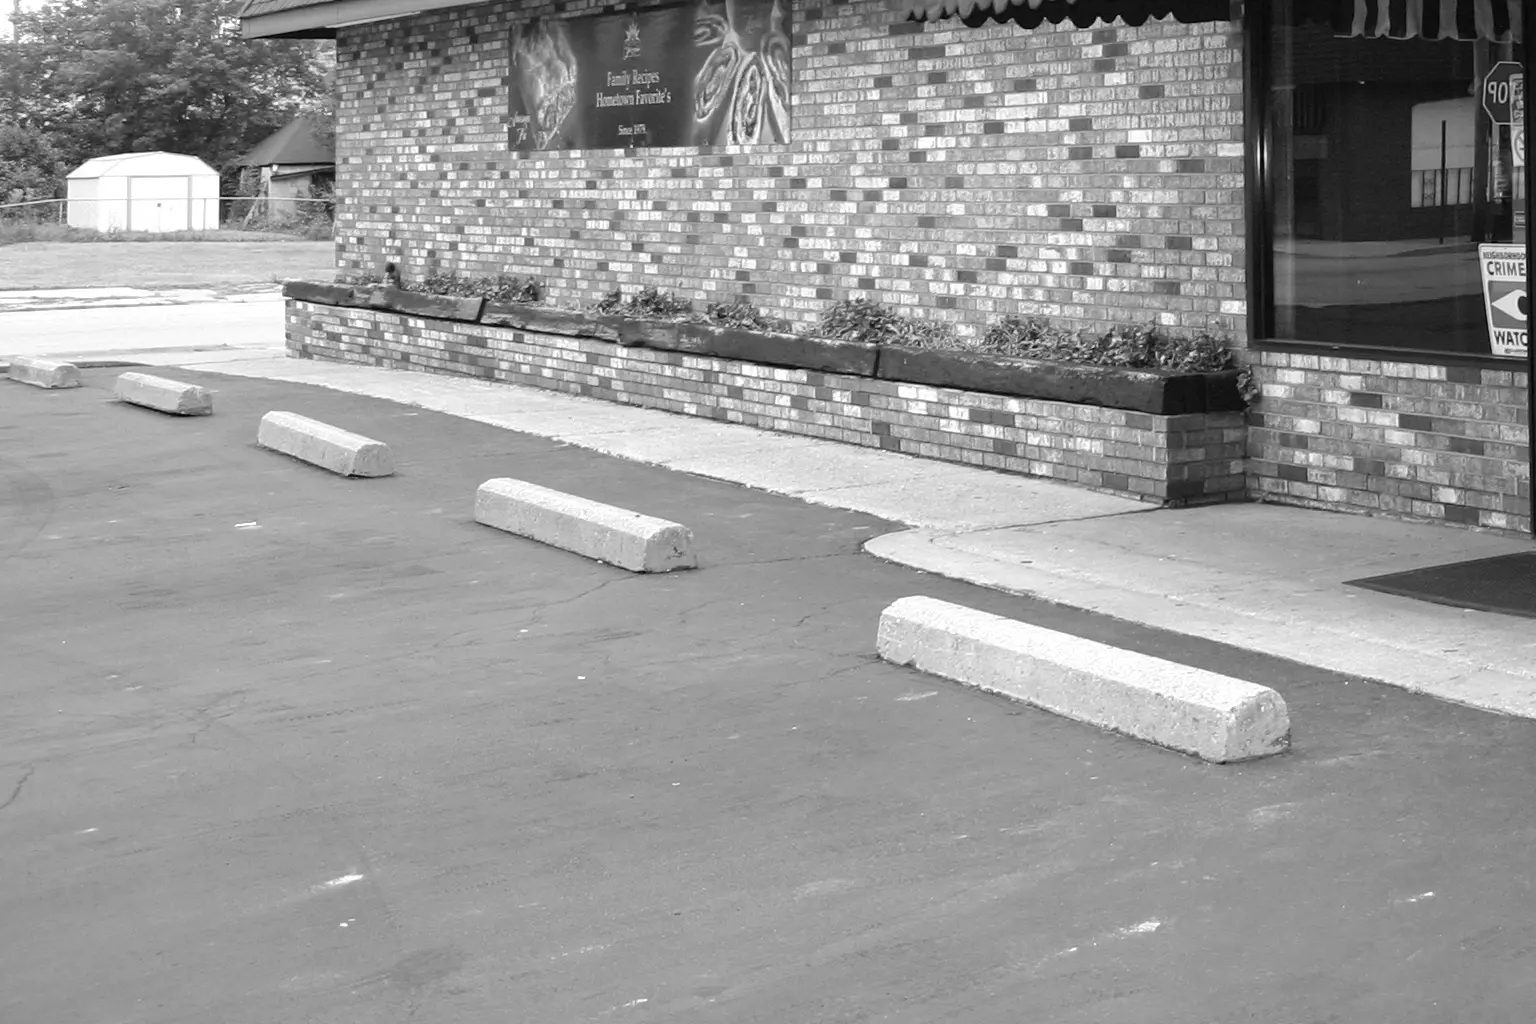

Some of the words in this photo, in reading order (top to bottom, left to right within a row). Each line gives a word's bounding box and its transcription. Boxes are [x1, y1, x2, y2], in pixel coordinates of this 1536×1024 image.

[607, 70, 631, 91] Family
[632, 68, 660, 89] Recipes
[596, 91, 635, 108] Hometown
[635, 87, 671, 105] Favorite's
[1483, 251, 1527, 261] NEIGHBORHOO
[1487, 261, 1527, 276] CRIME
[1494, 330, 1528, 346] WATC
